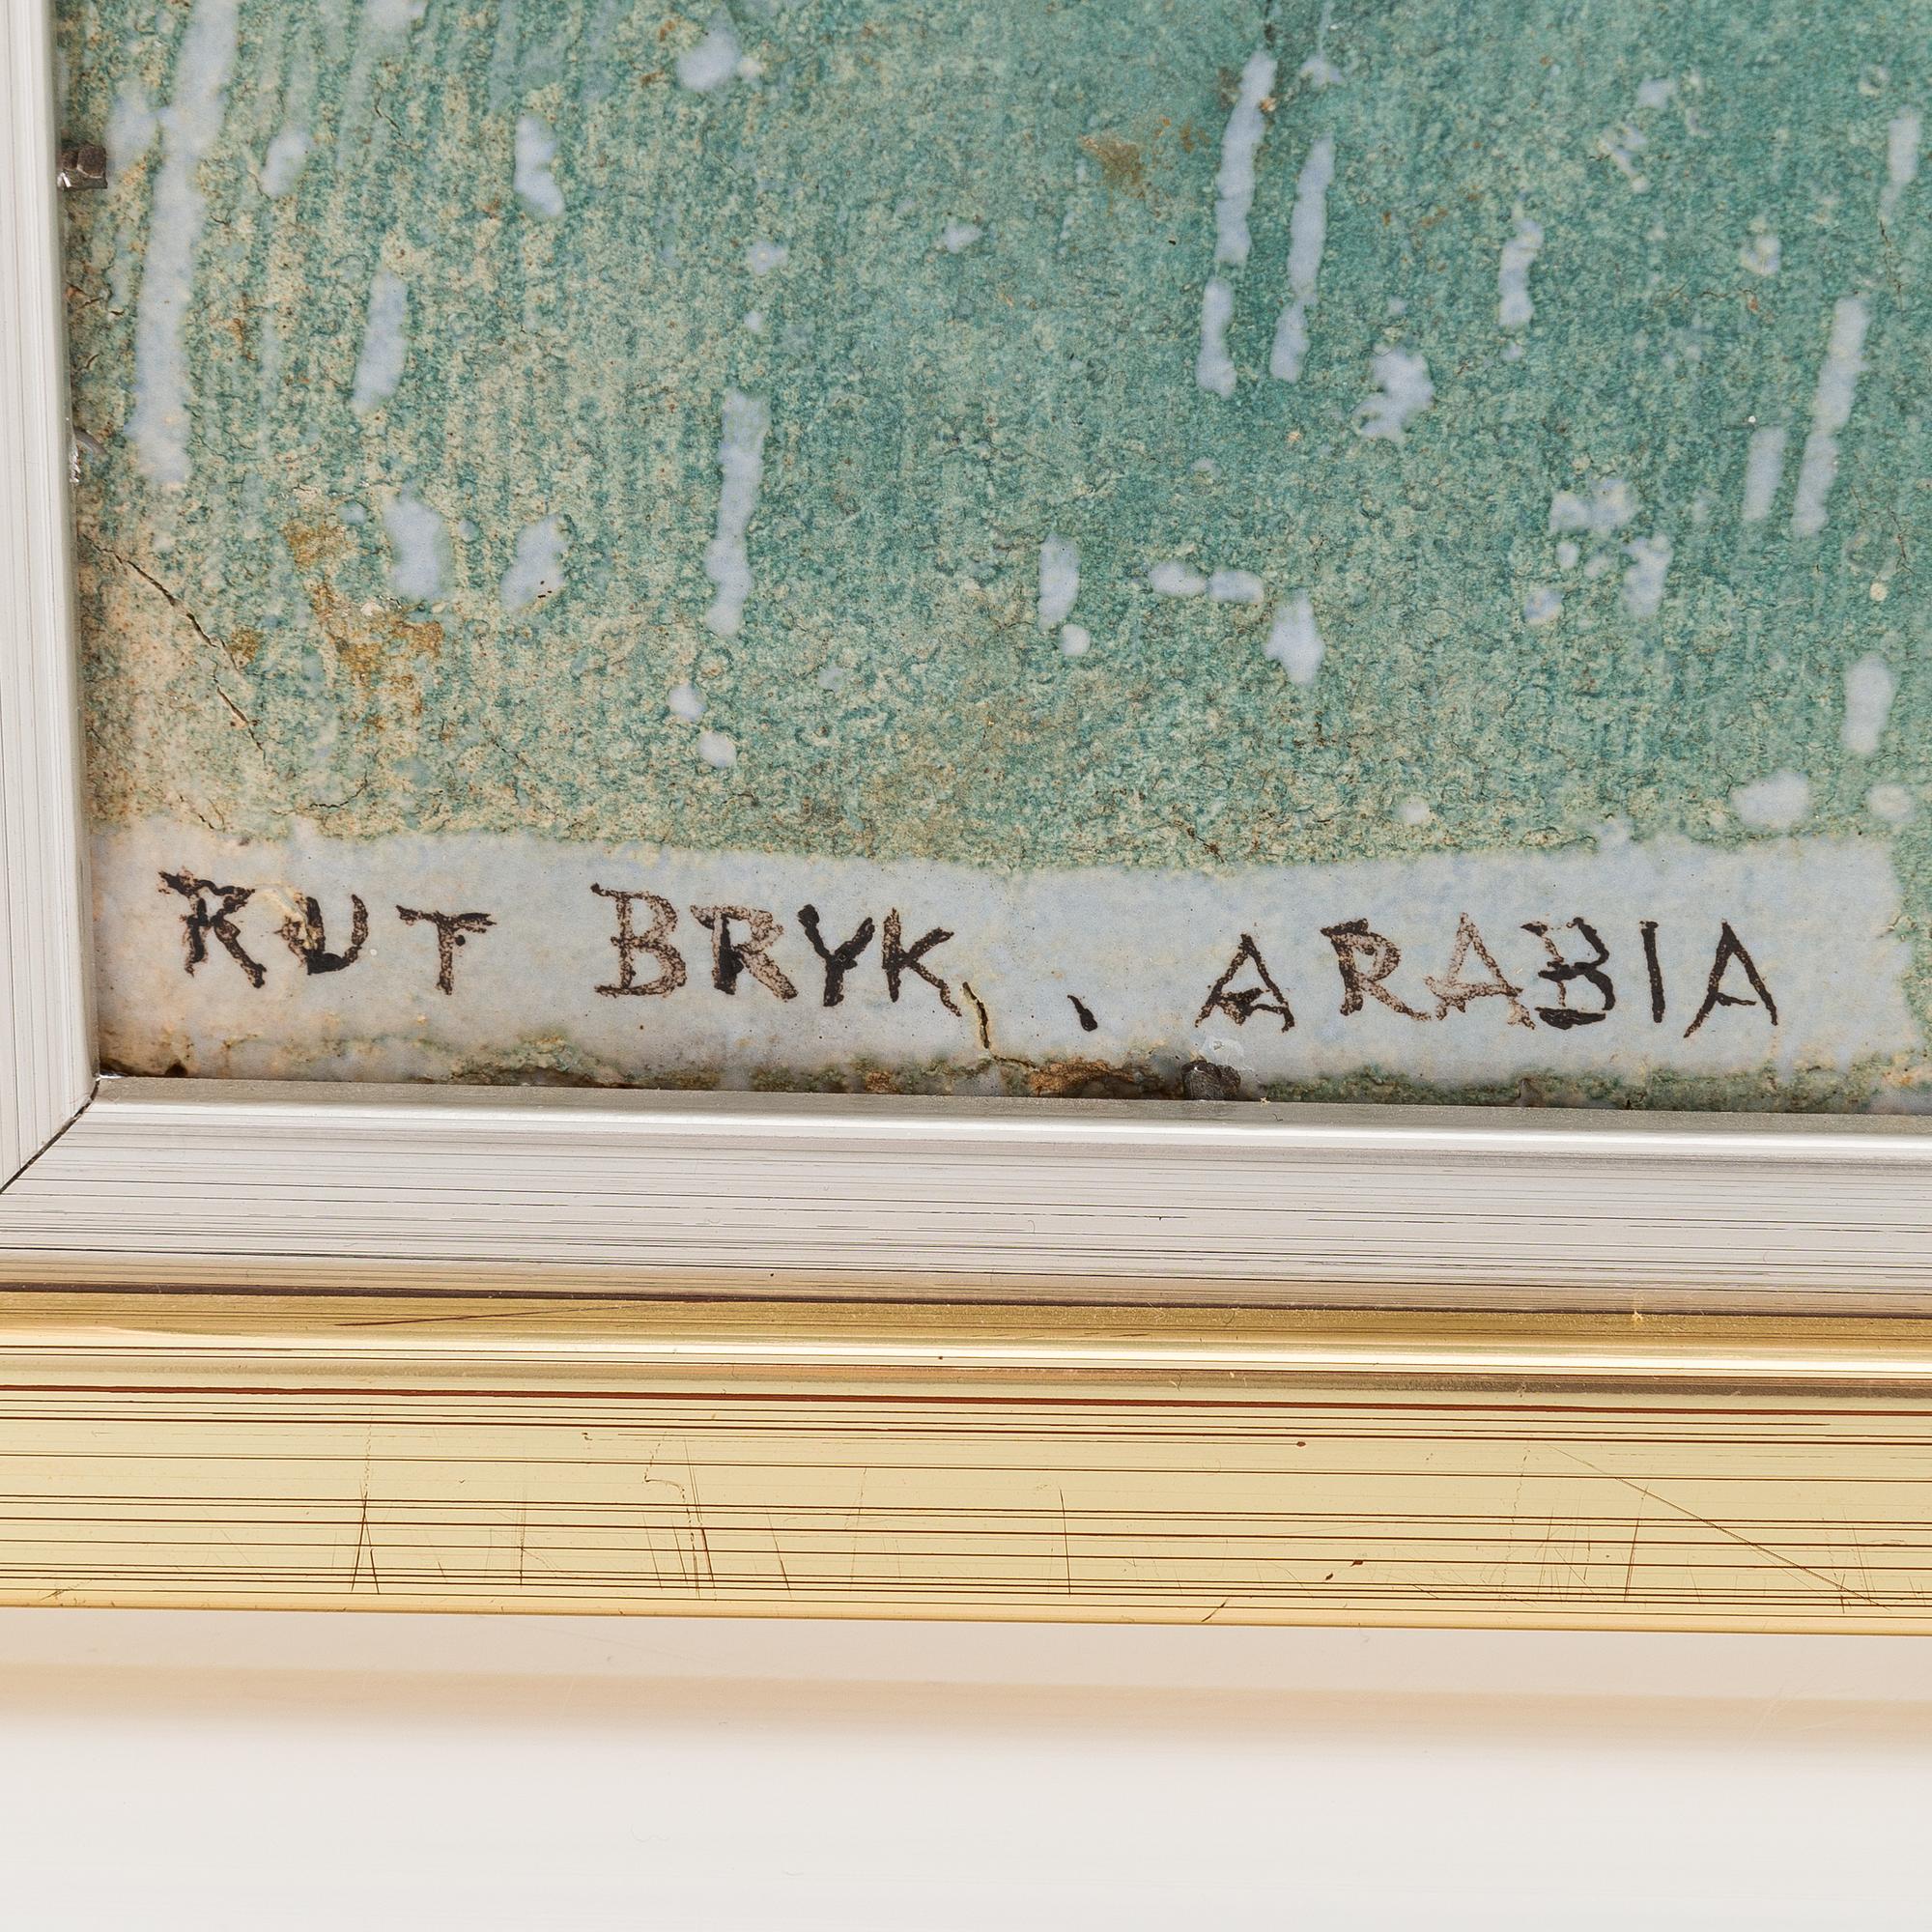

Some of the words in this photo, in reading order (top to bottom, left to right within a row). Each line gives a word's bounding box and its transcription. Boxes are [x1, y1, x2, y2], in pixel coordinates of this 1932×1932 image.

[157, 867, 497, 996] RUT
[589, 882, 962, 1017] BRYK
[1194, 912, 1779, 1039] ARABIA
